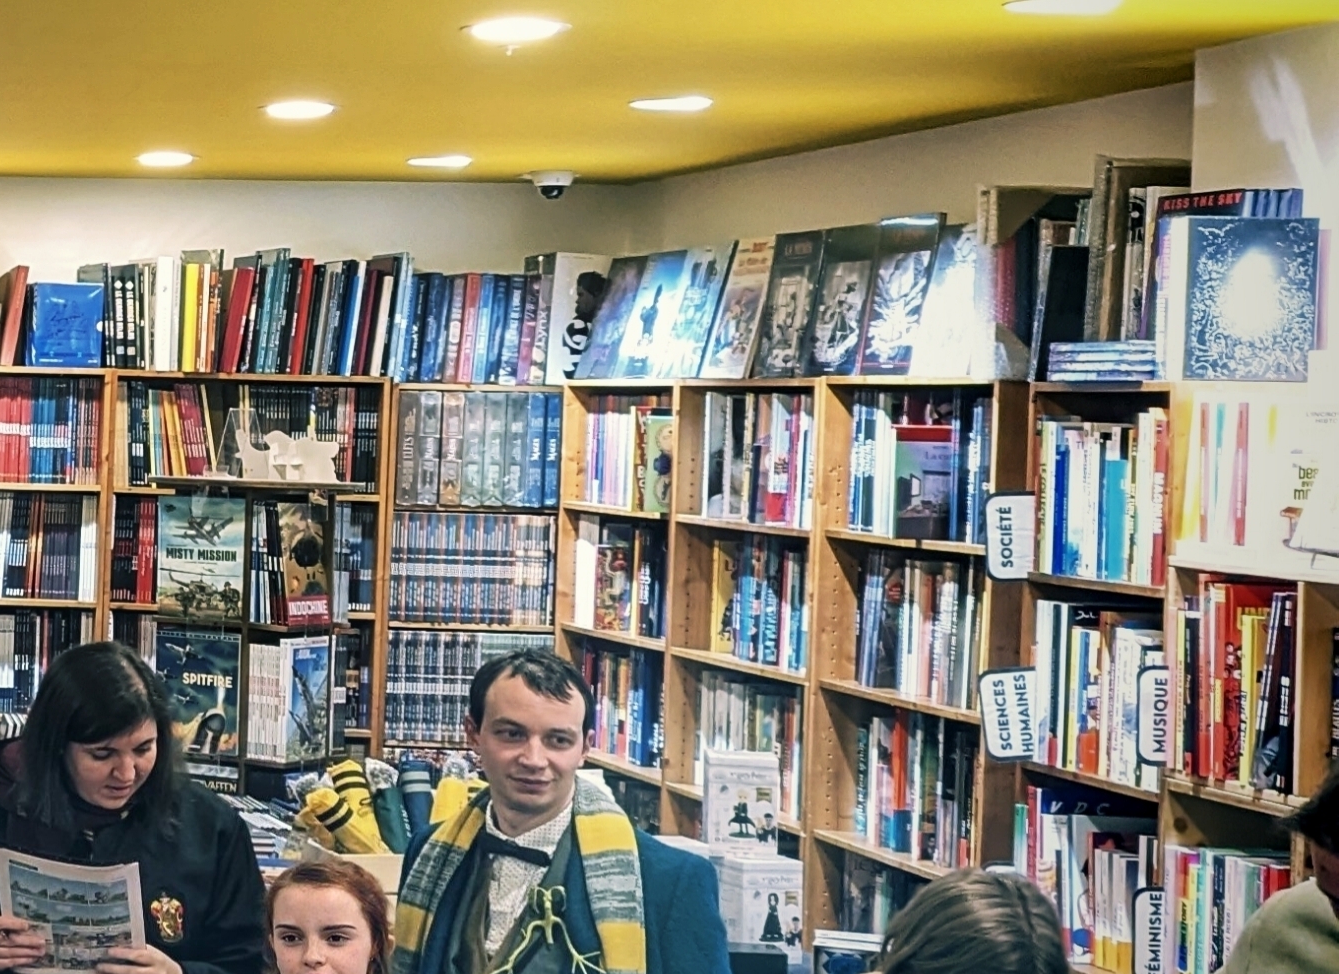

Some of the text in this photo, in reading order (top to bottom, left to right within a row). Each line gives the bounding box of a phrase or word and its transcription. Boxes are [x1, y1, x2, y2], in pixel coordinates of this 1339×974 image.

[166, 547, 237, 562] MISTY MISSION
[995, 506, 1013, 568] SOCIÉTÉ
[288, 600, 328, 616] INDOCHINE
[182, 672, 233, 689] SPITFIRE
[992, 679, 1013, 751] SCIENCES
[1013, 674, 1034, 754] HUMAINES
[1153, 677, 1169, 754] MUSIQUE
